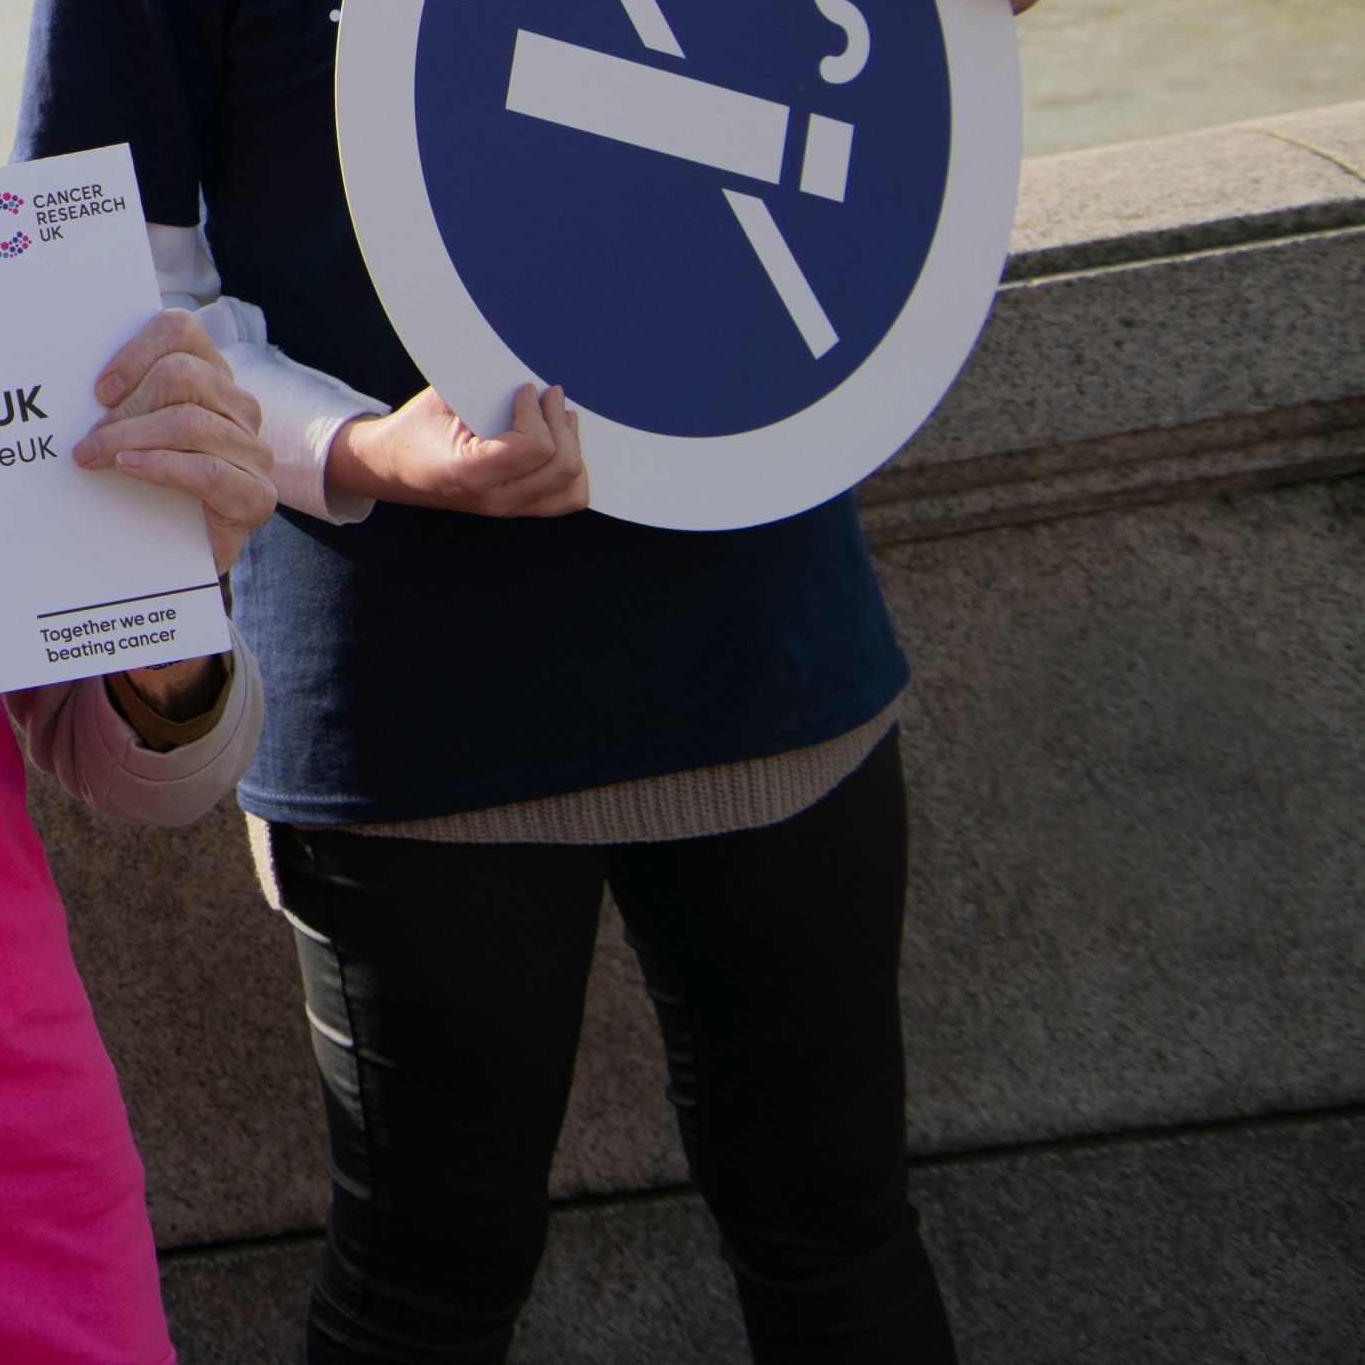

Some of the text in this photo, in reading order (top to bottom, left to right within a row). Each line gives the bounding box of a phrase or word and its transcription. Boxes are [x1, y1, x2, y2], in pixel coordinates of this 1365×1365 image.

[33, 184, 103, 209] CANCER
[36, 196, 126, 226] RESEARCH
[39, 225, 64, 242] UK
[40, 608, 177, 643] Together we are
[46, 629, 176, 662] beating cancer
